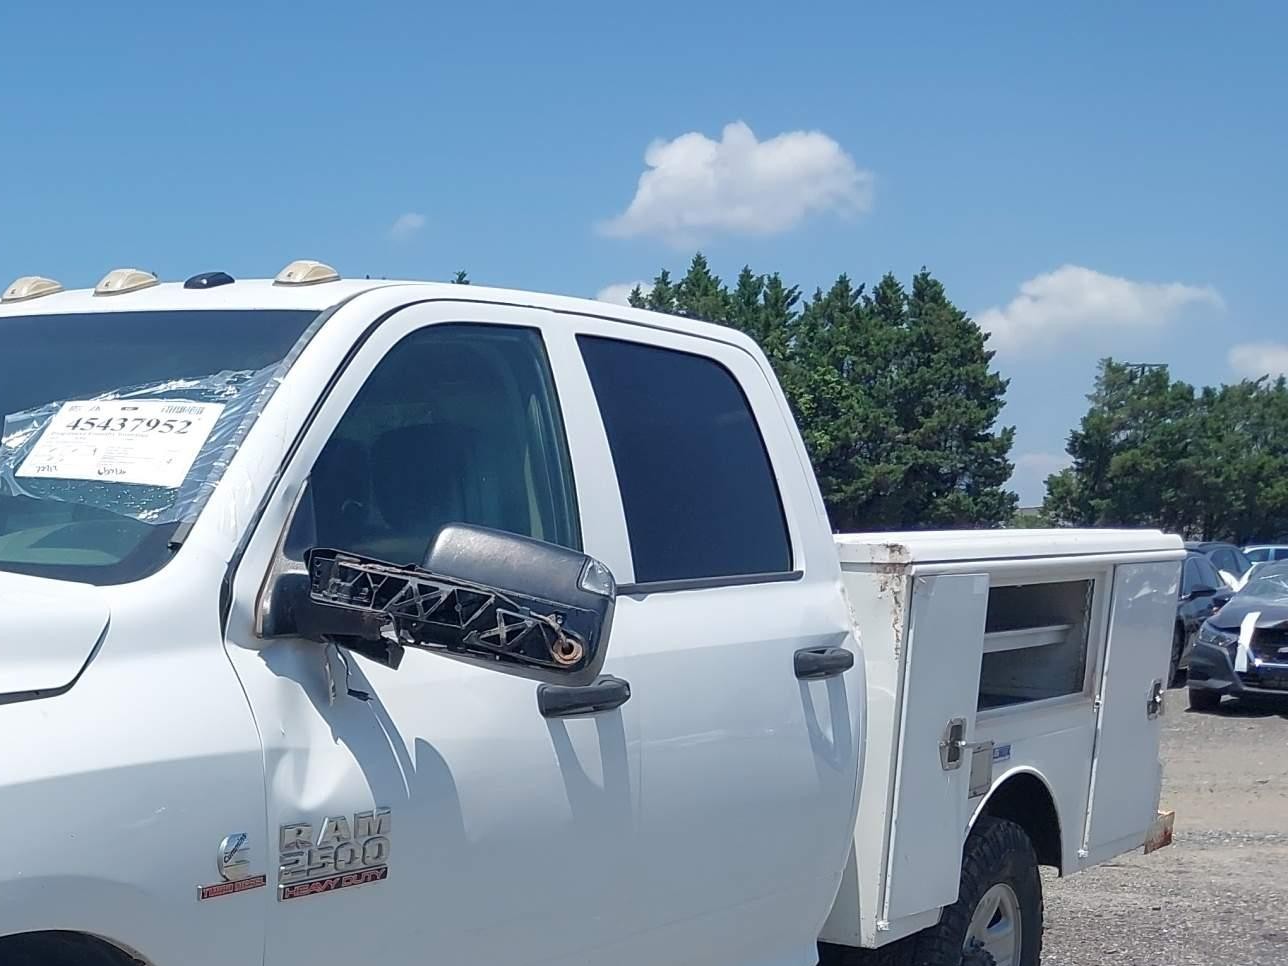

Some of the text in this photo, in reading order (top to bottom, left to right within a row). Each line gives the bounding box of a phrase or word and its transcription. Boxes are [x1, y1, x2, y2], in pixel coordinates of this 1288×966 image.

[65, 416, 193, 434] 45437952
[279, 806, 392, 851] RAM
[223, 832, 248, 863] Cummins
[279, 836, 391, 883] 2500
[284, 867, 387, 899] HEAVY DUTY
